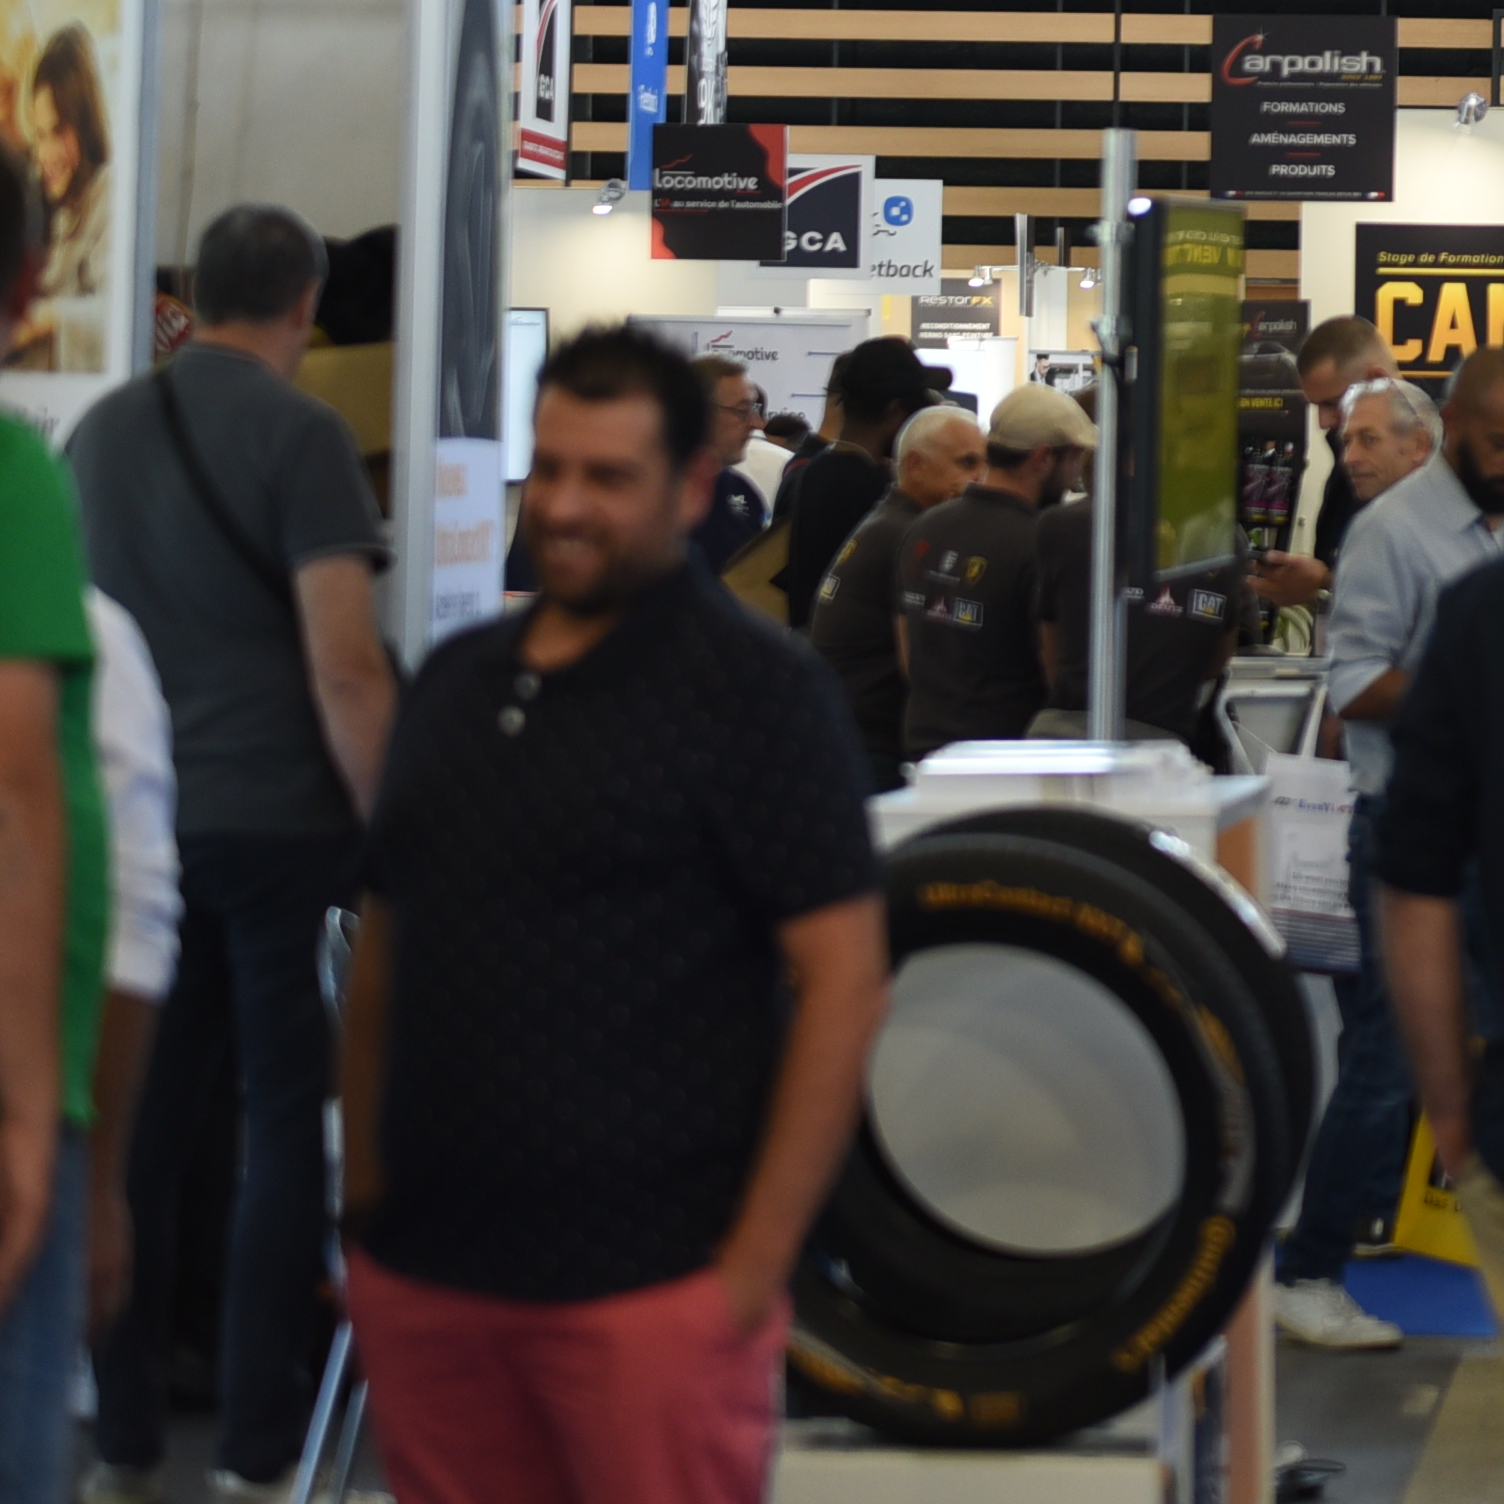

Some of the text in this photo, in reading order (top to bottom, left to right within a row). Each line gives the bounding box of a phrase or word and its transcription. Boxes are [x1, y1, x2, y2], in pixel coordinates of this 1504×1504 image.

[1221, 34, 1383, 86] Carpolish
[1260, 101, 1346, 114] FORMATIONS
[1249, 131, 1357, 146] AMÉNAGEMENTS
[1269, 164, 1336, 177] PRODUITS
[685, 200, 717, 208] service
[718, 199, 730, 208] de
[1378, 251, 1415, 265] Stage
[1420, 251, 1436, 264] de
[1438, 251, 1504, 265] Formation
